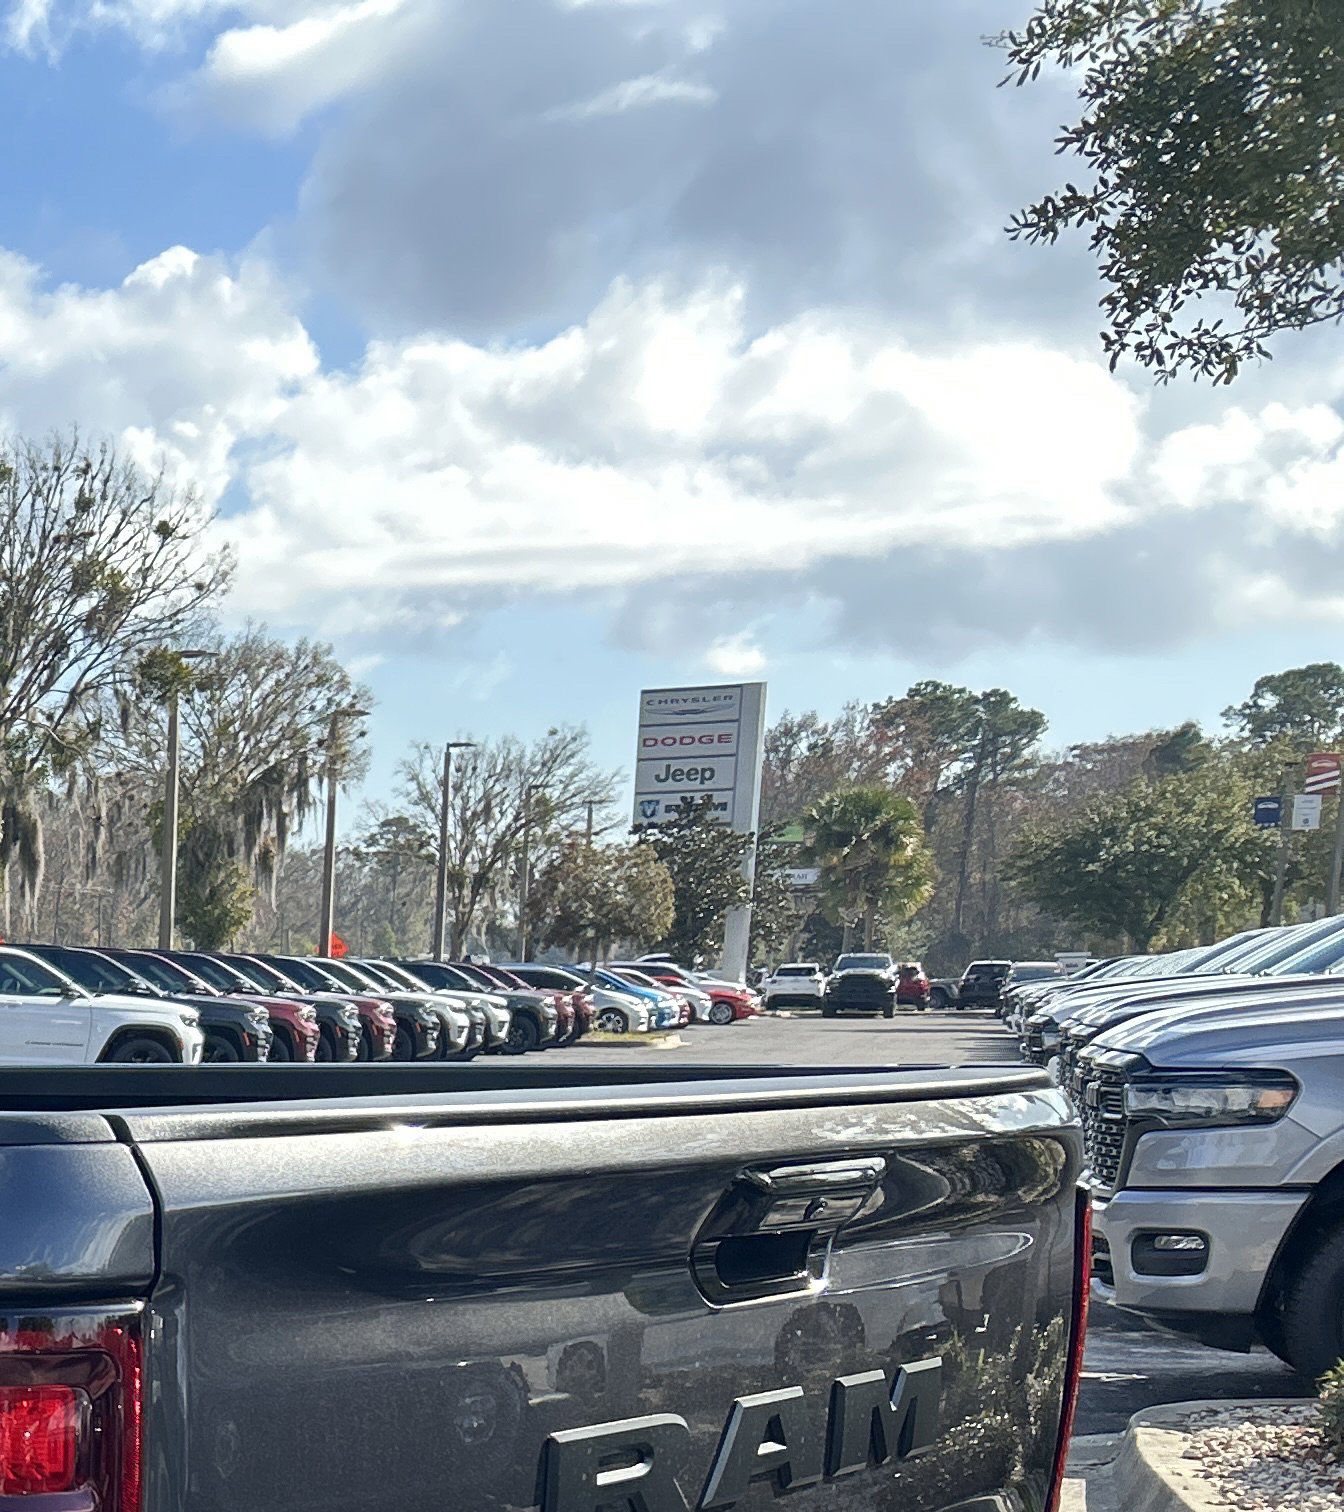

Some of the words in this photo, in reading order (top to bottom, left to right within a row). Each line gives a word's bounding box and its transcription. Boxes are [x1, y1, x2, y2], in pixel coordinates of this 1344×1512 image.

[645, 694, 734, 706] CHRYSLER
[642, 733, 733, 748] DODGE
[654, 763, 716, 785] Jeep
